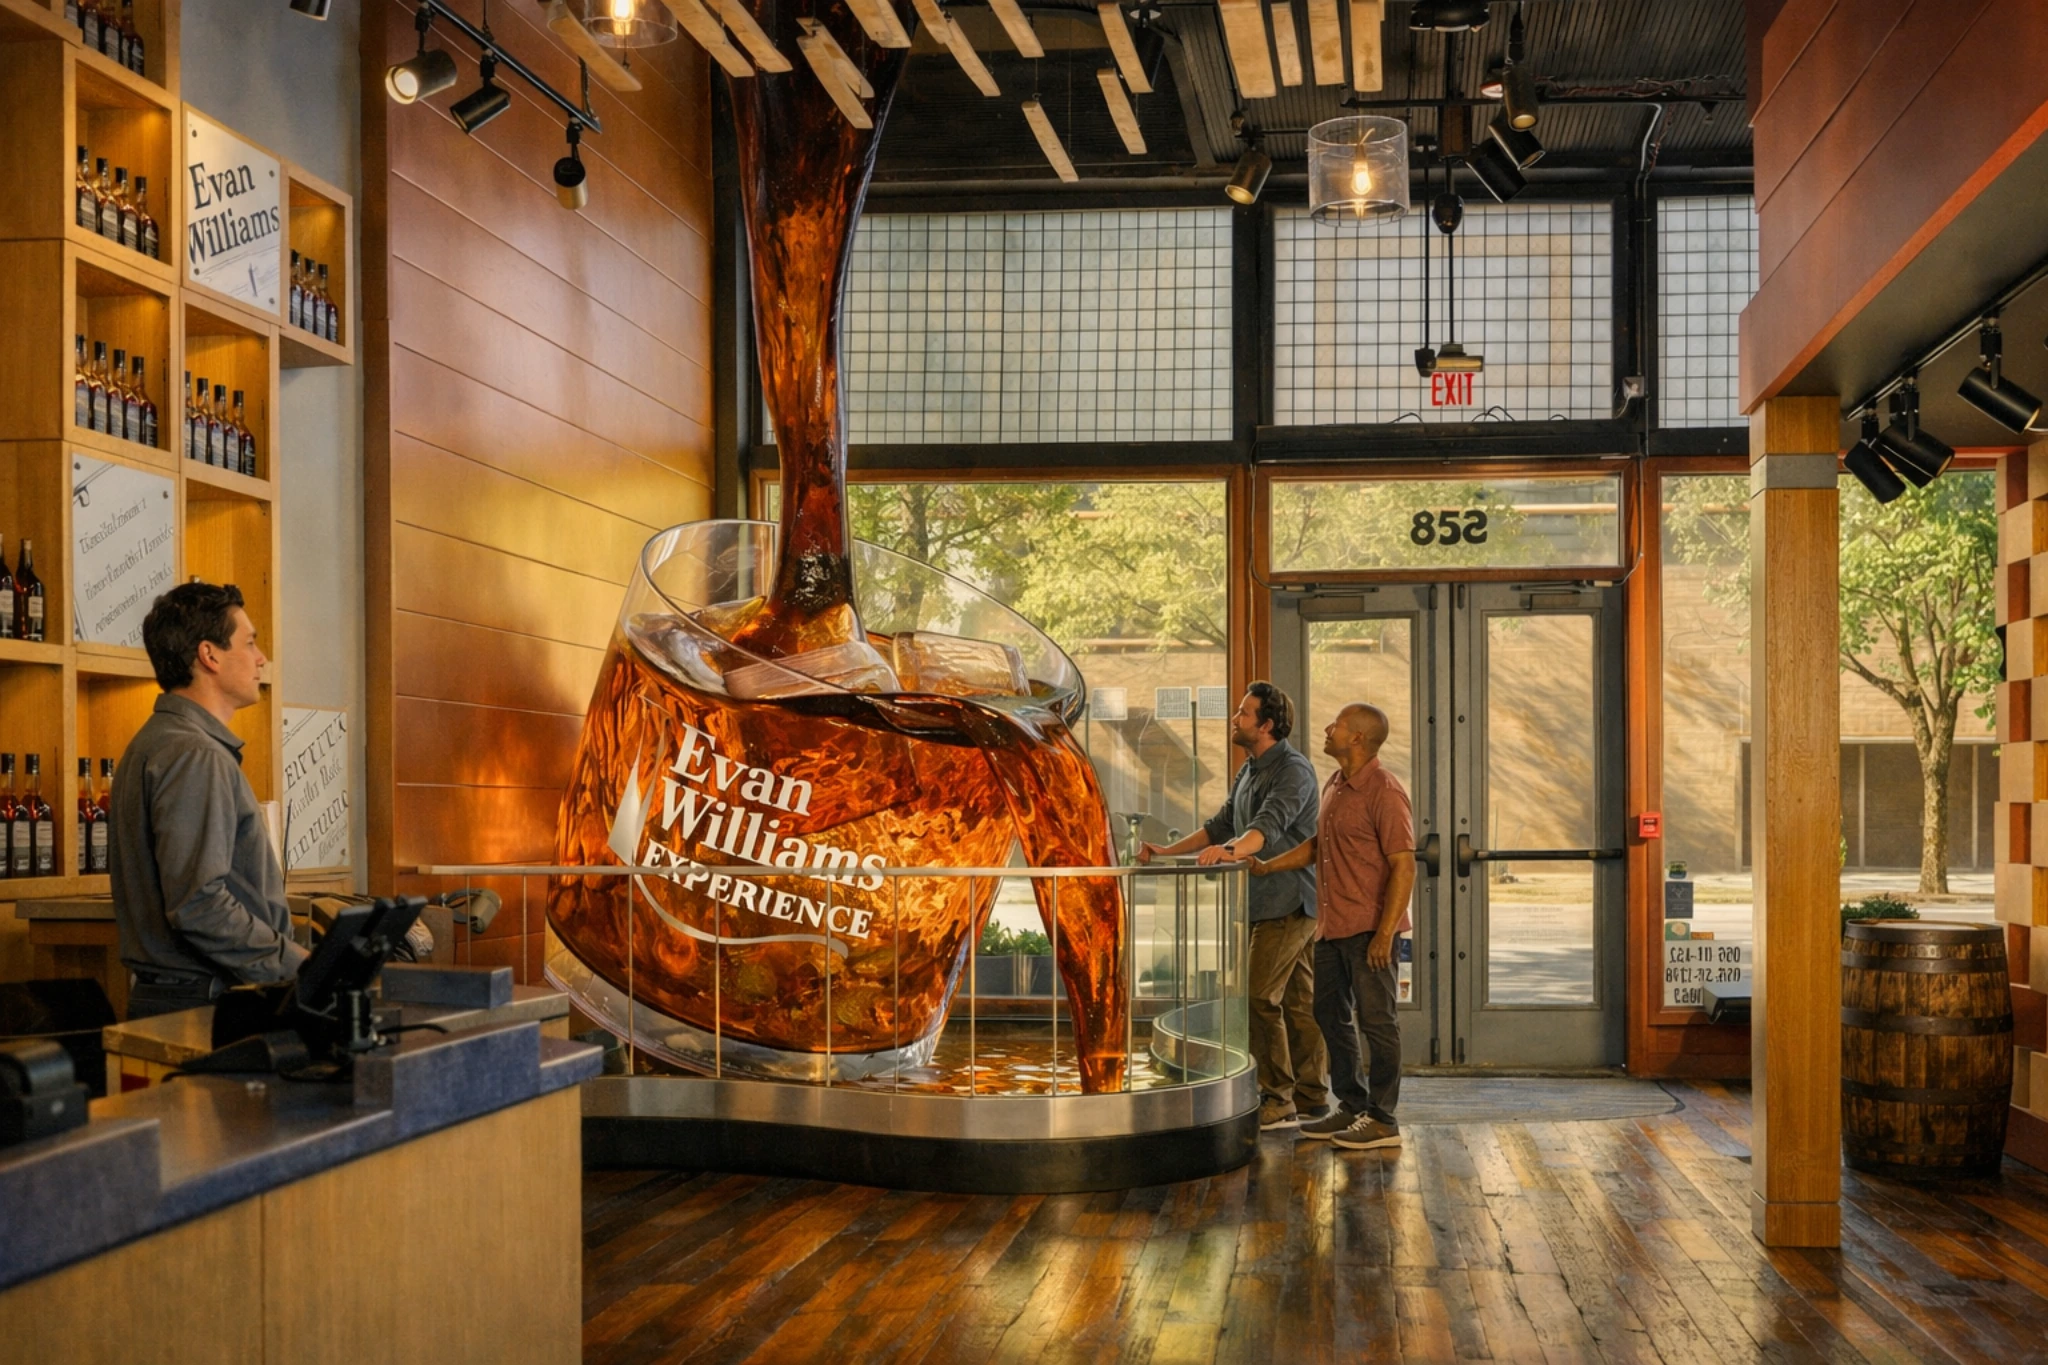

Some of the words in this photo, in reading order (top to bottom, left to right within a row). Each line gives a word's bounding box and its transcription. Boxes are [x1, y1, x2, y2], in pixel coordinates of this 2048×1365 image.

[188, 162, 255, 209] Evan
[188, 205, 280, 264] Williams
[1431, 372, 1475, 406] EXIT
[669, 722, 813, 817] Evan
[660, 776, 887, 892] Williams
[640, 838, 874, 940] EXPERIENCE
